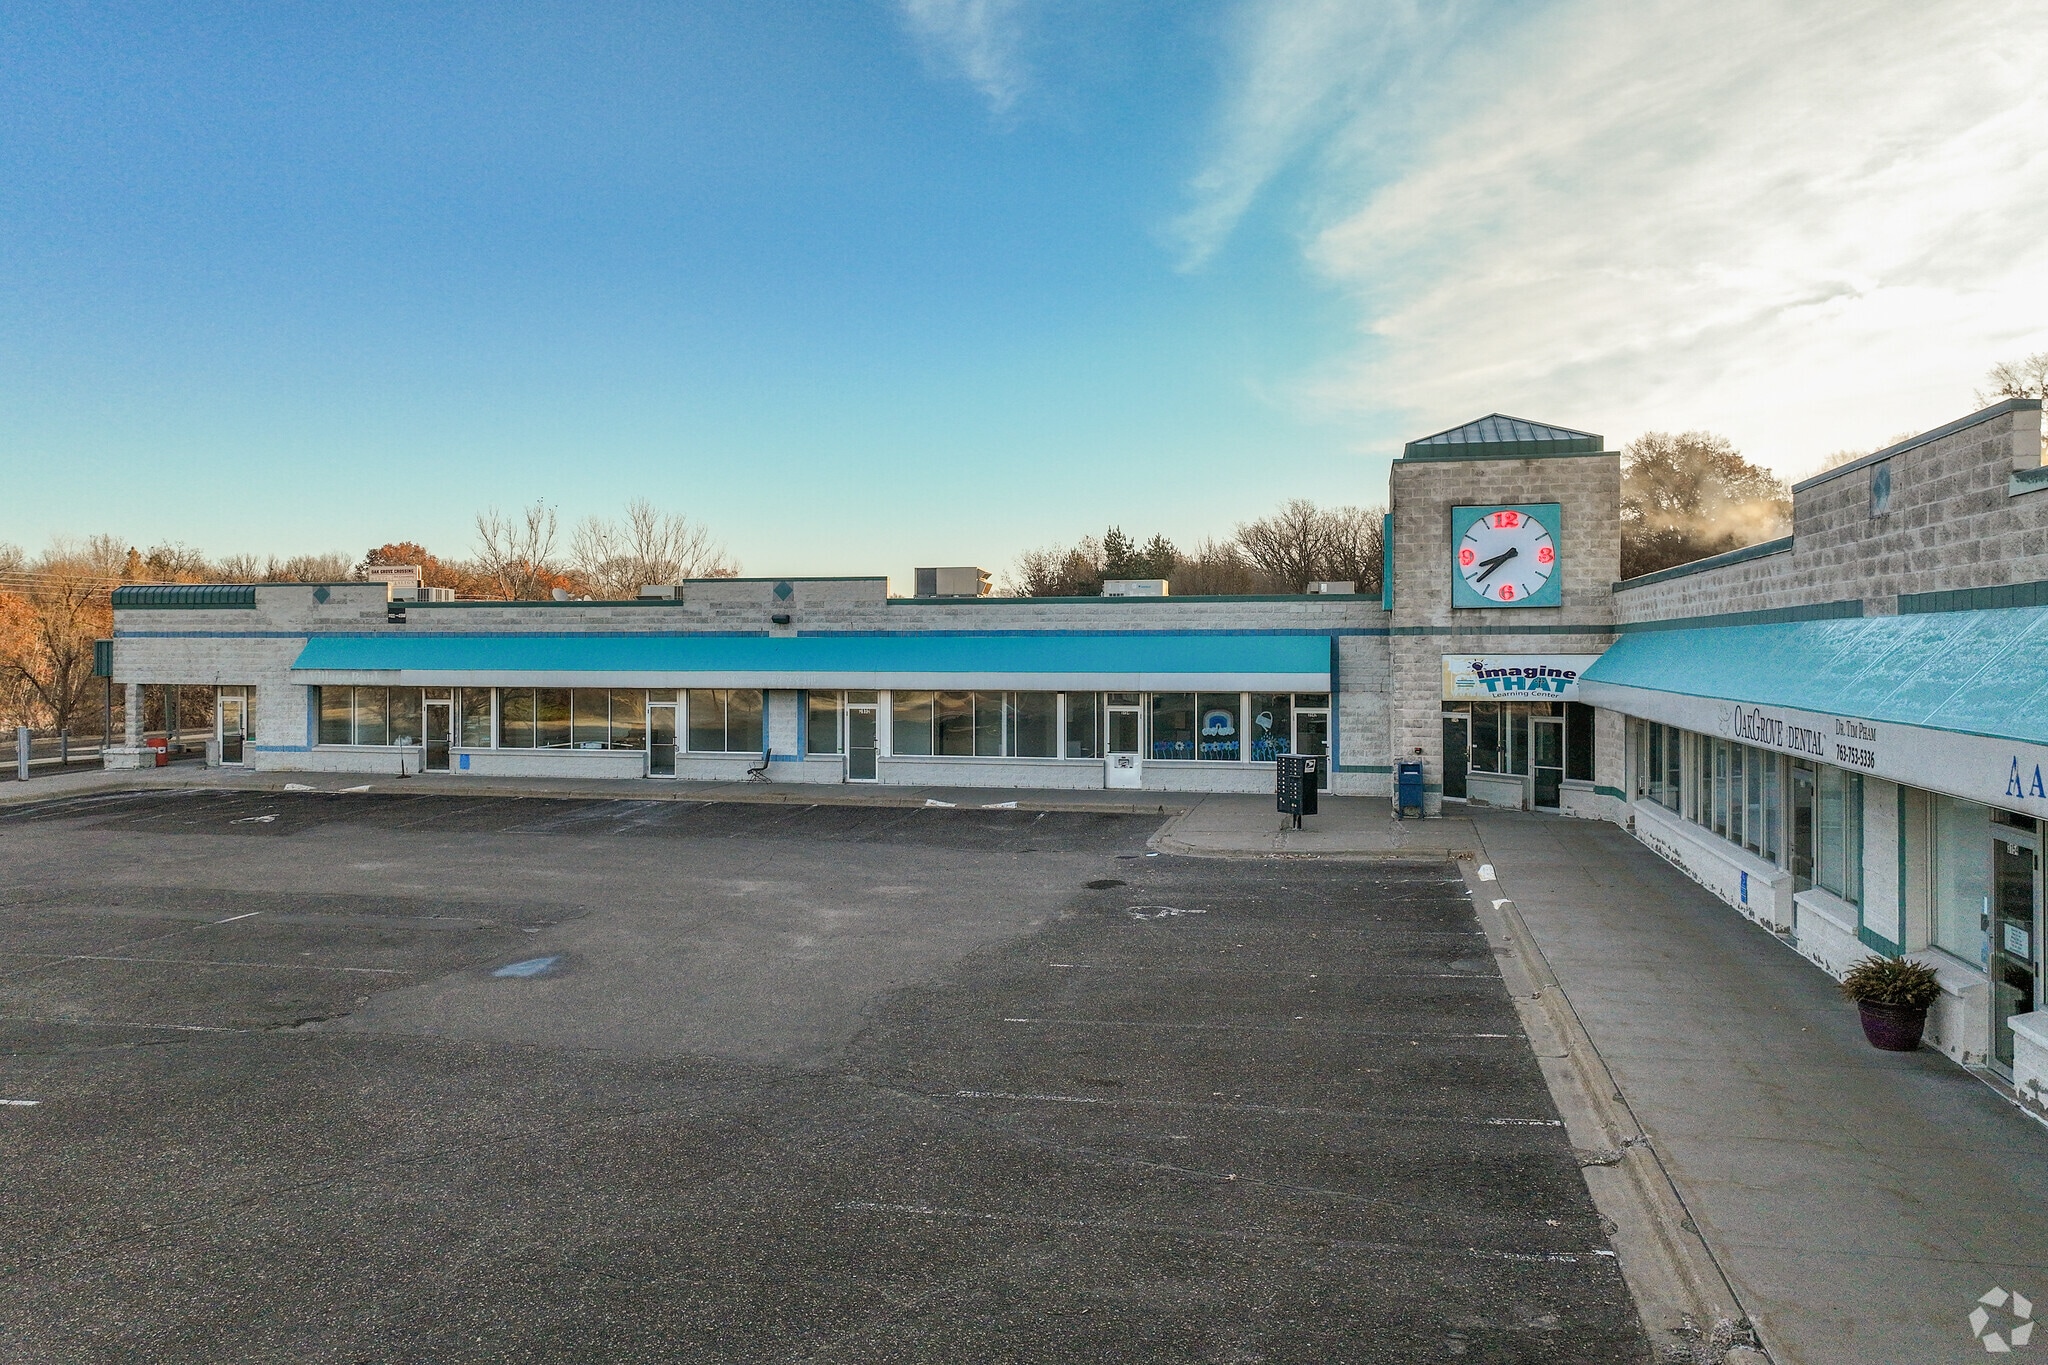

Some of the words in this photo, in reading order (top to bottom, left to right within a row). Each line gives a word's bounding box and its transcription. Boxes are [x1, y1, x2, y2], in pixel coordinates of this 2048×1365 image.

[1494, 511, 1519, 528] 12
[1461, 549, 1475, 566] 9
[1538, 547, 1553, 563] 3
[1499, 584, 1514, 600] 6
[1475, 664, 1577, 680] imagine
[1479, 677, 1574, 693] THAT
[1492, 690, 1529, 698] Learning
[1531, 690, 1559, 698] Center
[1788, 726, 1824, 756] DENTAL
[1836, 744, 1875, 769] 763-753-5336
